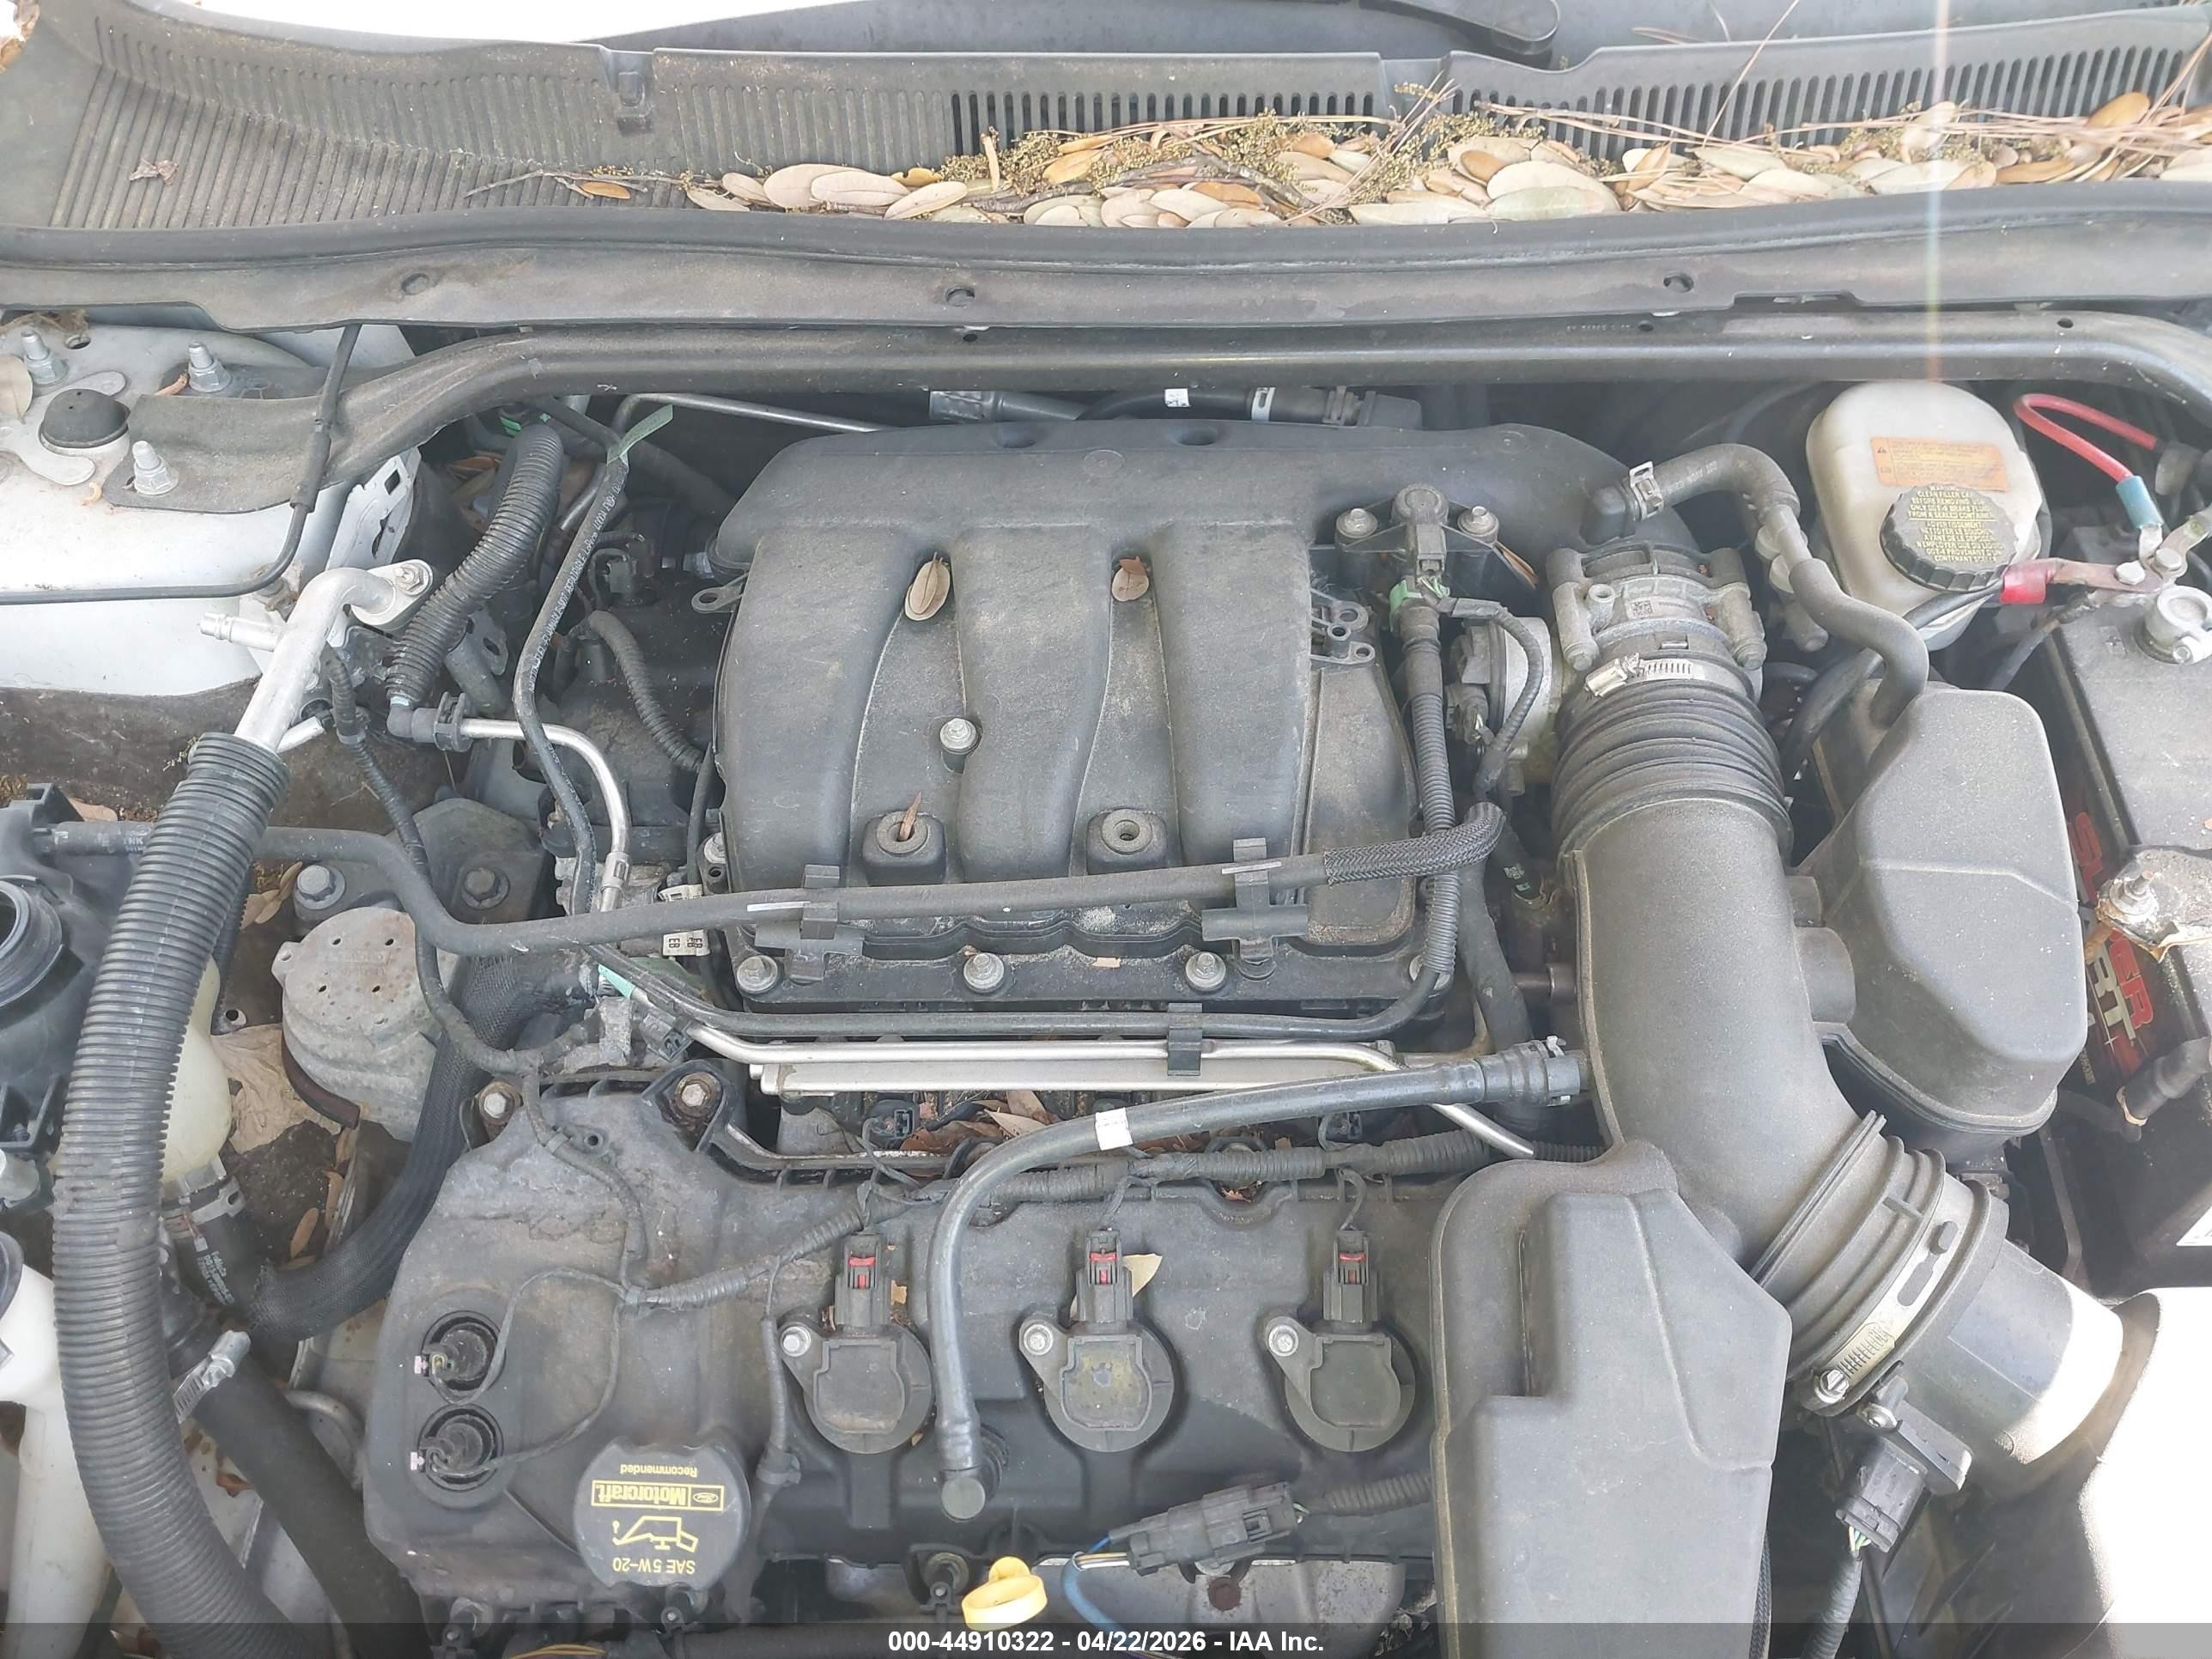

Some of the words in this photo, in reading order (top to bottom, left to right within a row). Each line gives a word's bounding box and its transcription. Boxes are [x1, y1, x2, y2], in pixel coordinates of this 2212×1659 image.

[668, 938, 680, 948] EB
[620, 1463, 698, 1478] Recommended
[612, 1557, 663, 1573] 5W-20
[665, 1559, 696, 1575] SAE
